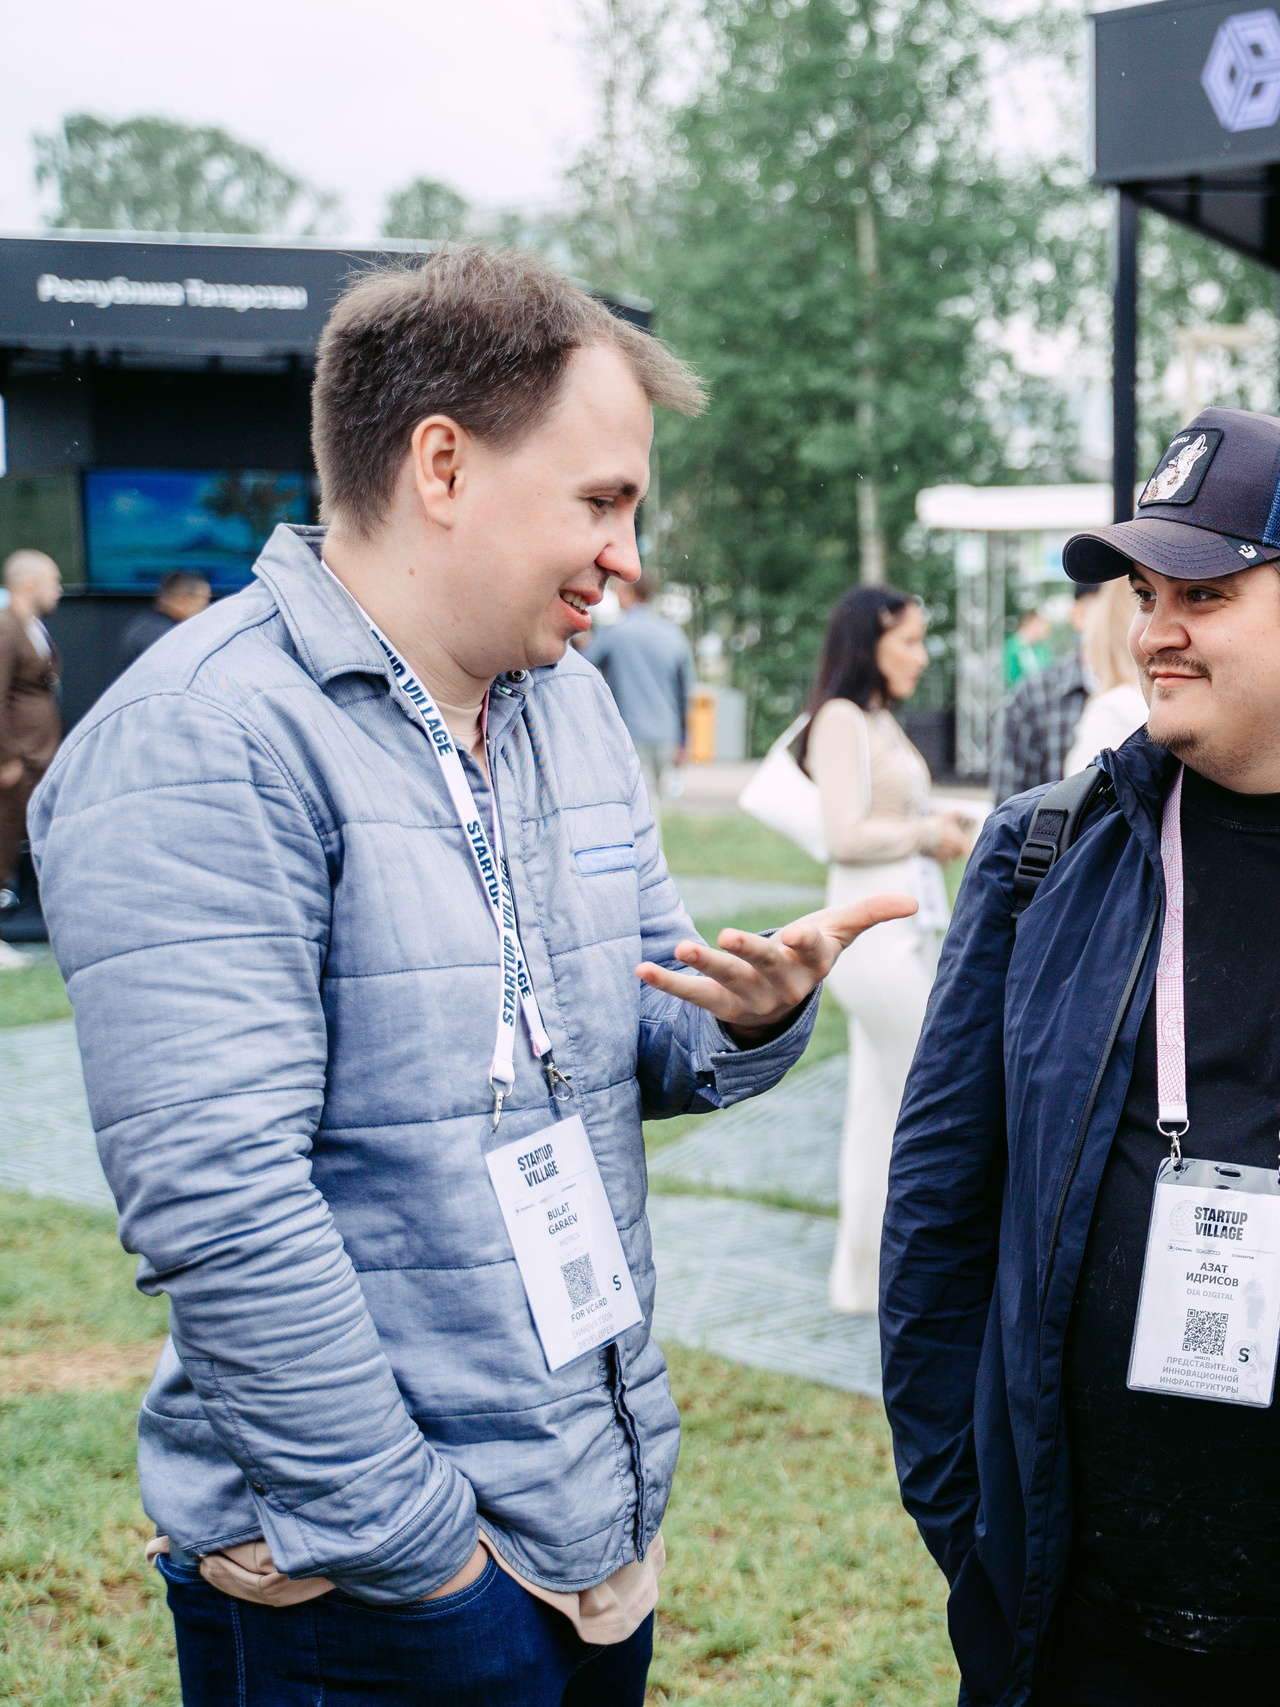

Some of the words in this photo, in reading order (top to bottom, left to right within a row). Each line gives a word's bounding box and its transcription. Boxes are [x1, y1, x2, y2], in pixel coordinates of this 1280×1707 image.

[402, 677, 454, 756] VILLAGE
[503, 935, 517, 1028] STARTUP
[517, 1143, 553, 1171] STARTUP
[524, 1160, 559, 1187] VILLAGE
[547, 1202, 570, 1221] BULAT
[1194, 1206, 1248, 1225] STARTUP
[548, 1213, 578, 1235] GARAEV
[1195, 1221, 1244, 1241] VILLAGE
[1200, 1262, 1229, 1274] АЗАТ
[613, 1274, 622, 1291] S
[1185, 1272, 1239, 1288] ИДРИСОВ
[1186, 1288, 1201, 1297] DIA
[1202, 1290, 1235, 1301] DIGITAL
[571, 1309, 586, 1323] FOR
[586, 1297, 608, 1315] VCARD
[571, 1310, 614, 1340] INNOVATION
[578, 1324, 615, 1350] DEVELOPER
[1166, 1356, 1238, 1373] ПРЕДСТАВИТЕЛЬ
[1238, 1347, 1250, 1363] S
[1162, 1366, 1239, 1383] ИННОВАЦИОННОЙ
[1160, 1376, 1239, 1394] ИНФРАСТРУКТУРЫ
